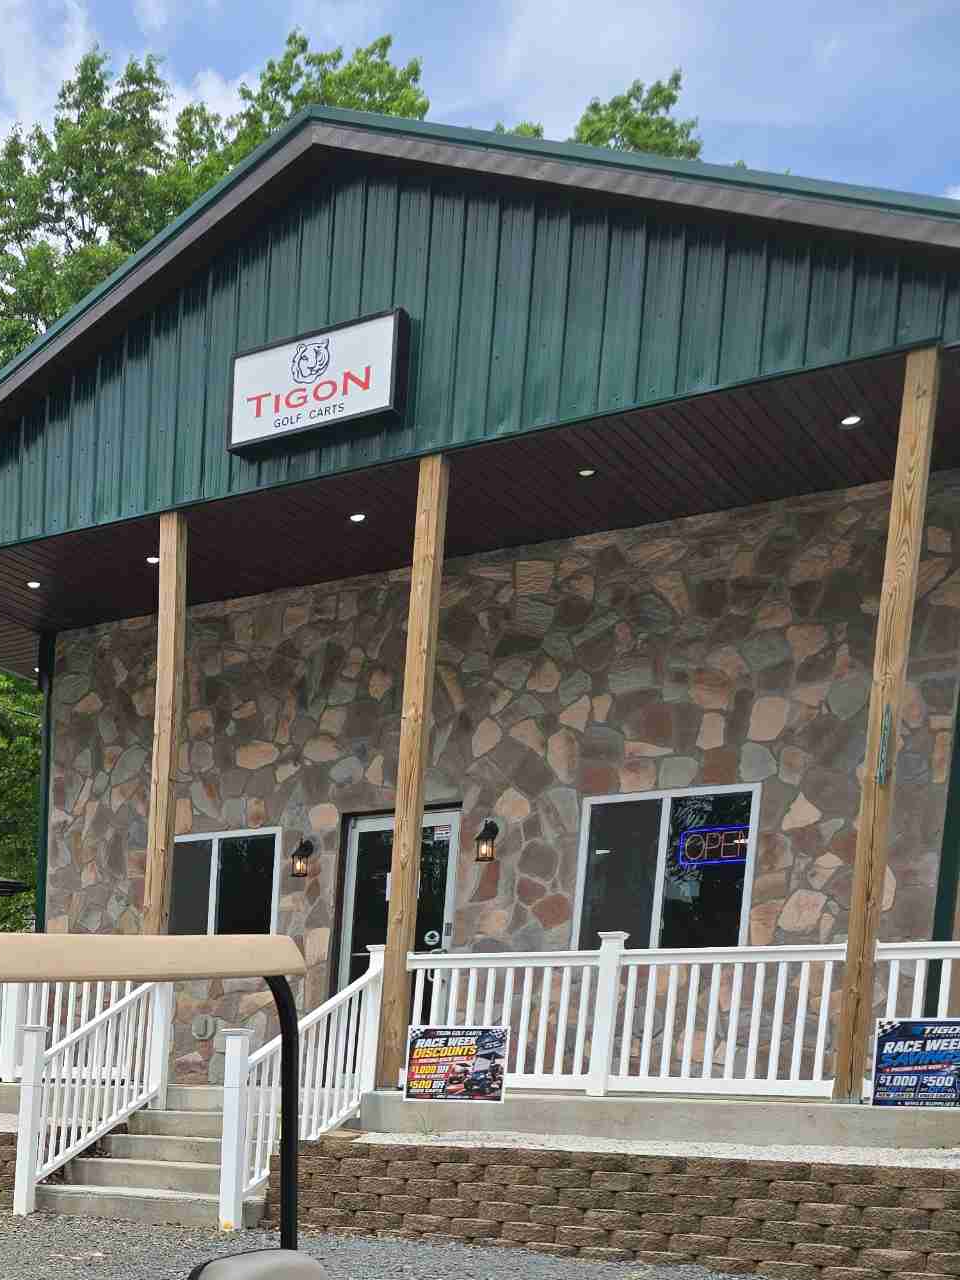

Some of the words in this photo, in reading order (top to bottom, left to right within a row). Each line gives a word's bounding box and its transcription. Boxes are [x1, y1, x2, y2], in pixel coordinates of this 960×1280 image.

[246, 365, 372, 418] TIGON
[273, 414, 303, 428] GOLF
[309, 402, 345, 420] CARTS
[924, 1026, 960, 1034] TIGO
[415, 1038, 446, 1048] RACE
[447, 1036, 478, 1047] WEEK
[883, 1041, 924, 1053] RACE
[925, 1039, 960, 1051] WEE
[413, 1046, 477, 1057] DISCOUNTS
[922, 1076, 954, 1087] $500
